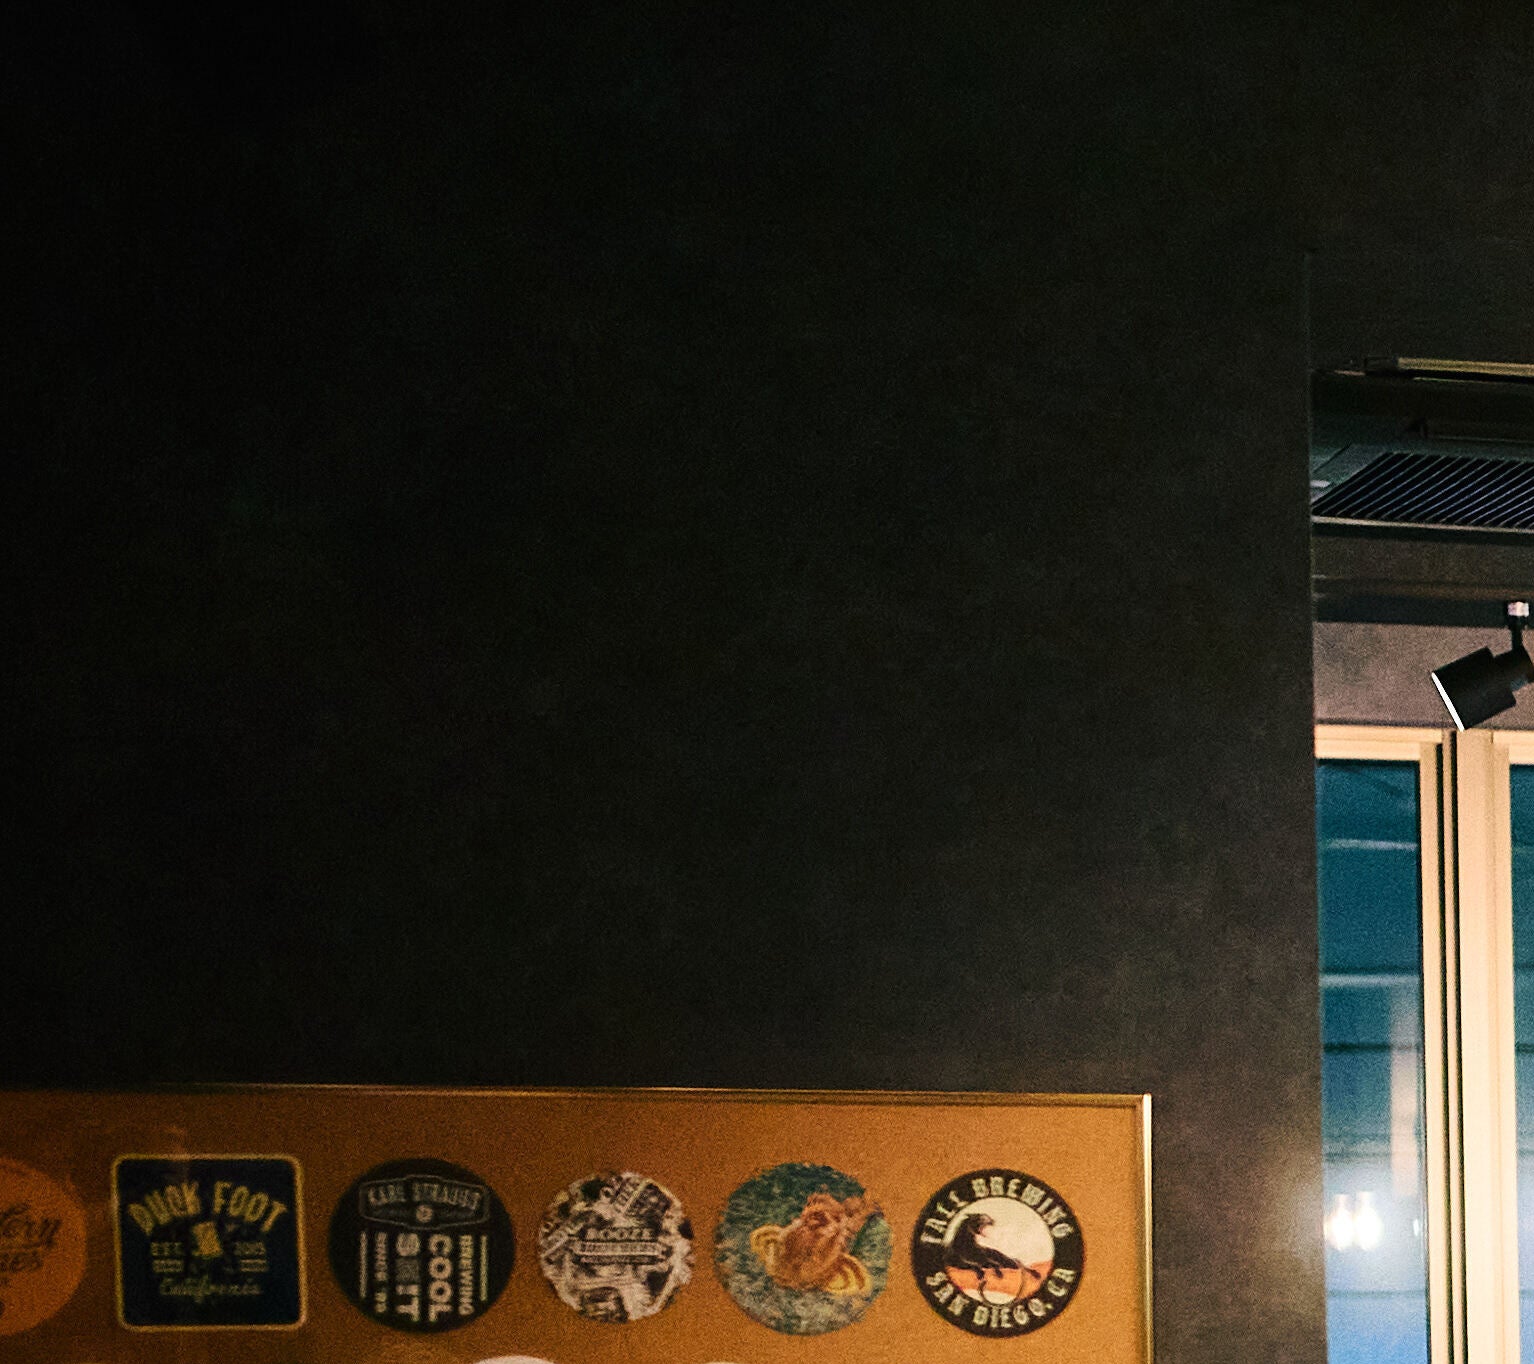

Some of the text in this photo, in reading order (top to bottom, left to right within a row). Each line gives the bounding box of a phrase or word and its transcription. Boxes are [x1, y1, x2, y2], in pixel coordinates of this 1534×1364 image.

[127, 1180, 288, 1236] DUCK FOOT
[972, 1176, 1074, 1238] BREWING
[428, 1233, 453, 1322] COOL
[925, 1268, 1075, 1316] SAN CA
